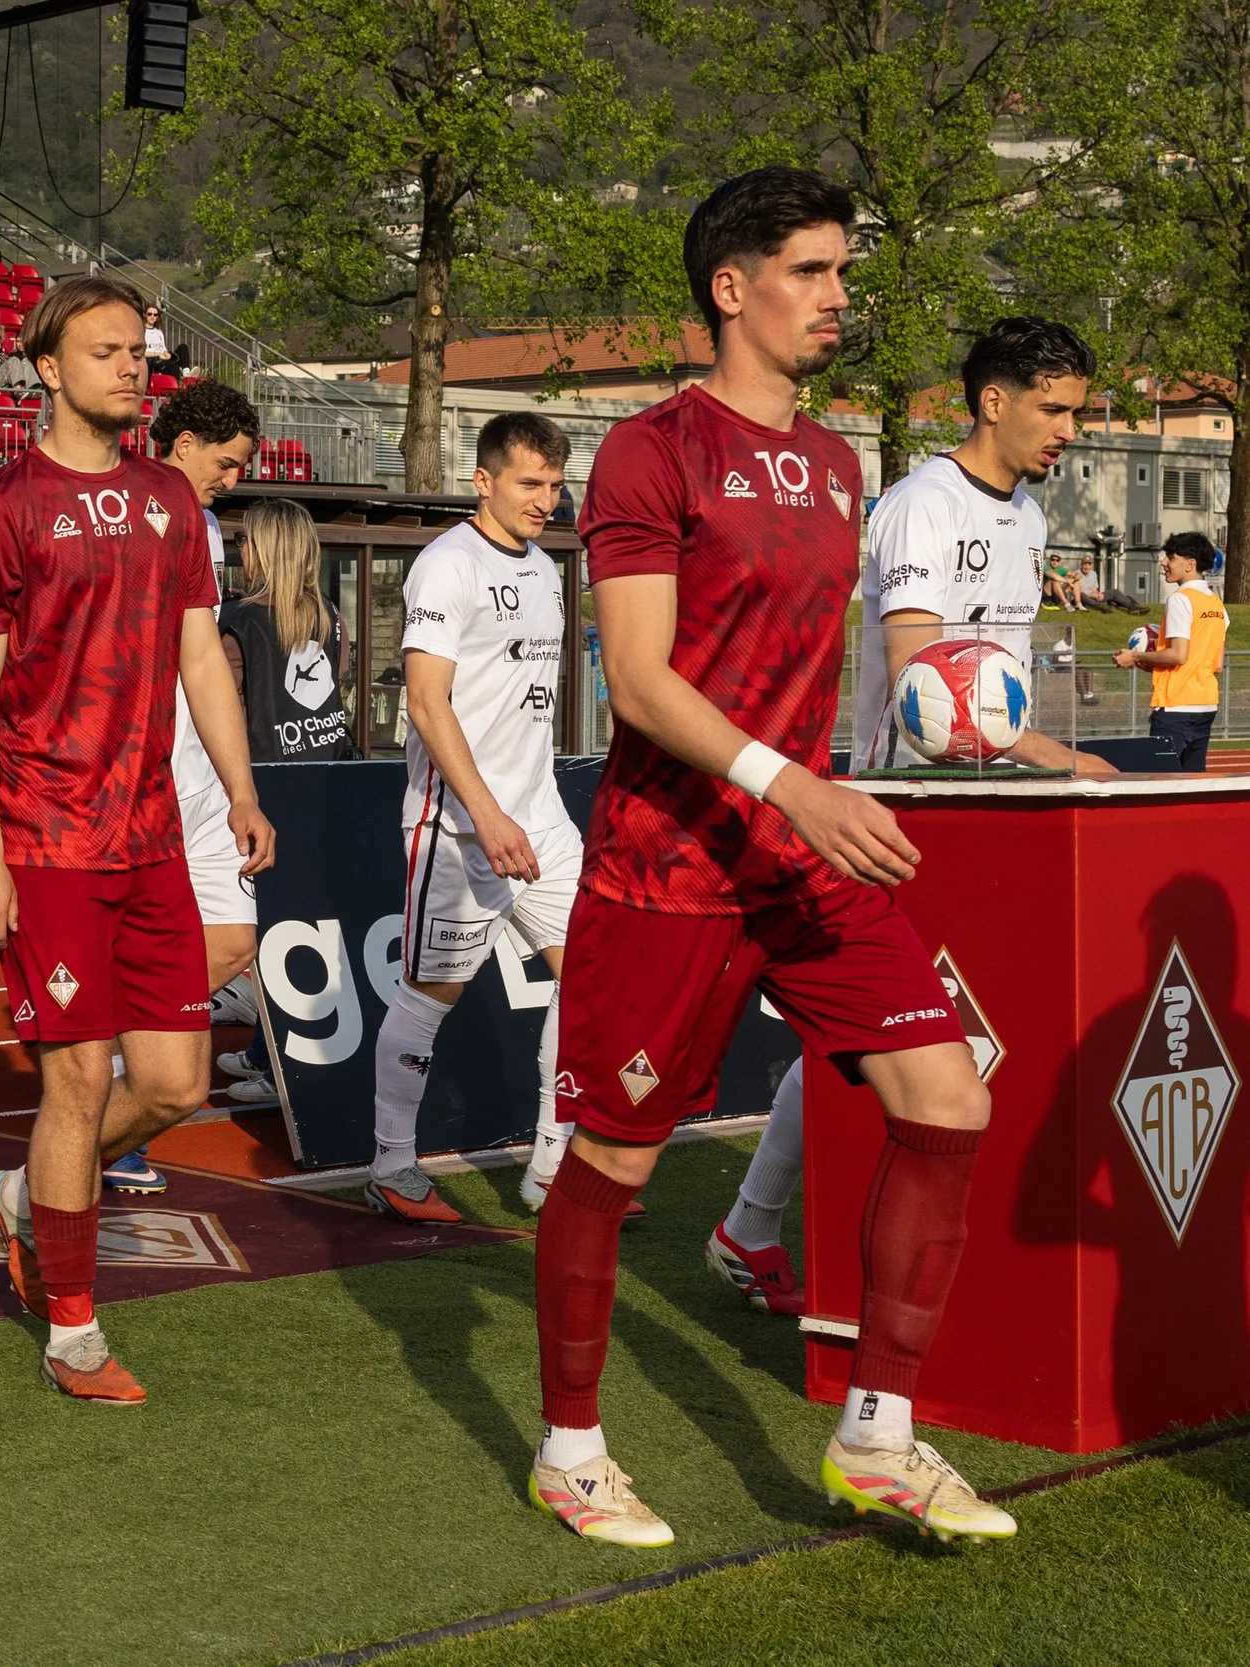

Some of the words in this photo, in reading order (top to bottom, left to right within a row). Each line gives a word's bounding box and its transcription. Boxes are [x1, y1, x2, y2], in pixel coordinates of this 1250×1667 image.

[774, 489, 815, 507] dieci
[94, 520, 133, 537] dieci
[954, 570, 989, 583] dieci
[496, 610, 524, 622] dieci
[282, 741, 307, 756] dieci
[881, 1008, 948, 1028] ACERBIS
[1141, 1076, 1215, 1201] ACB
